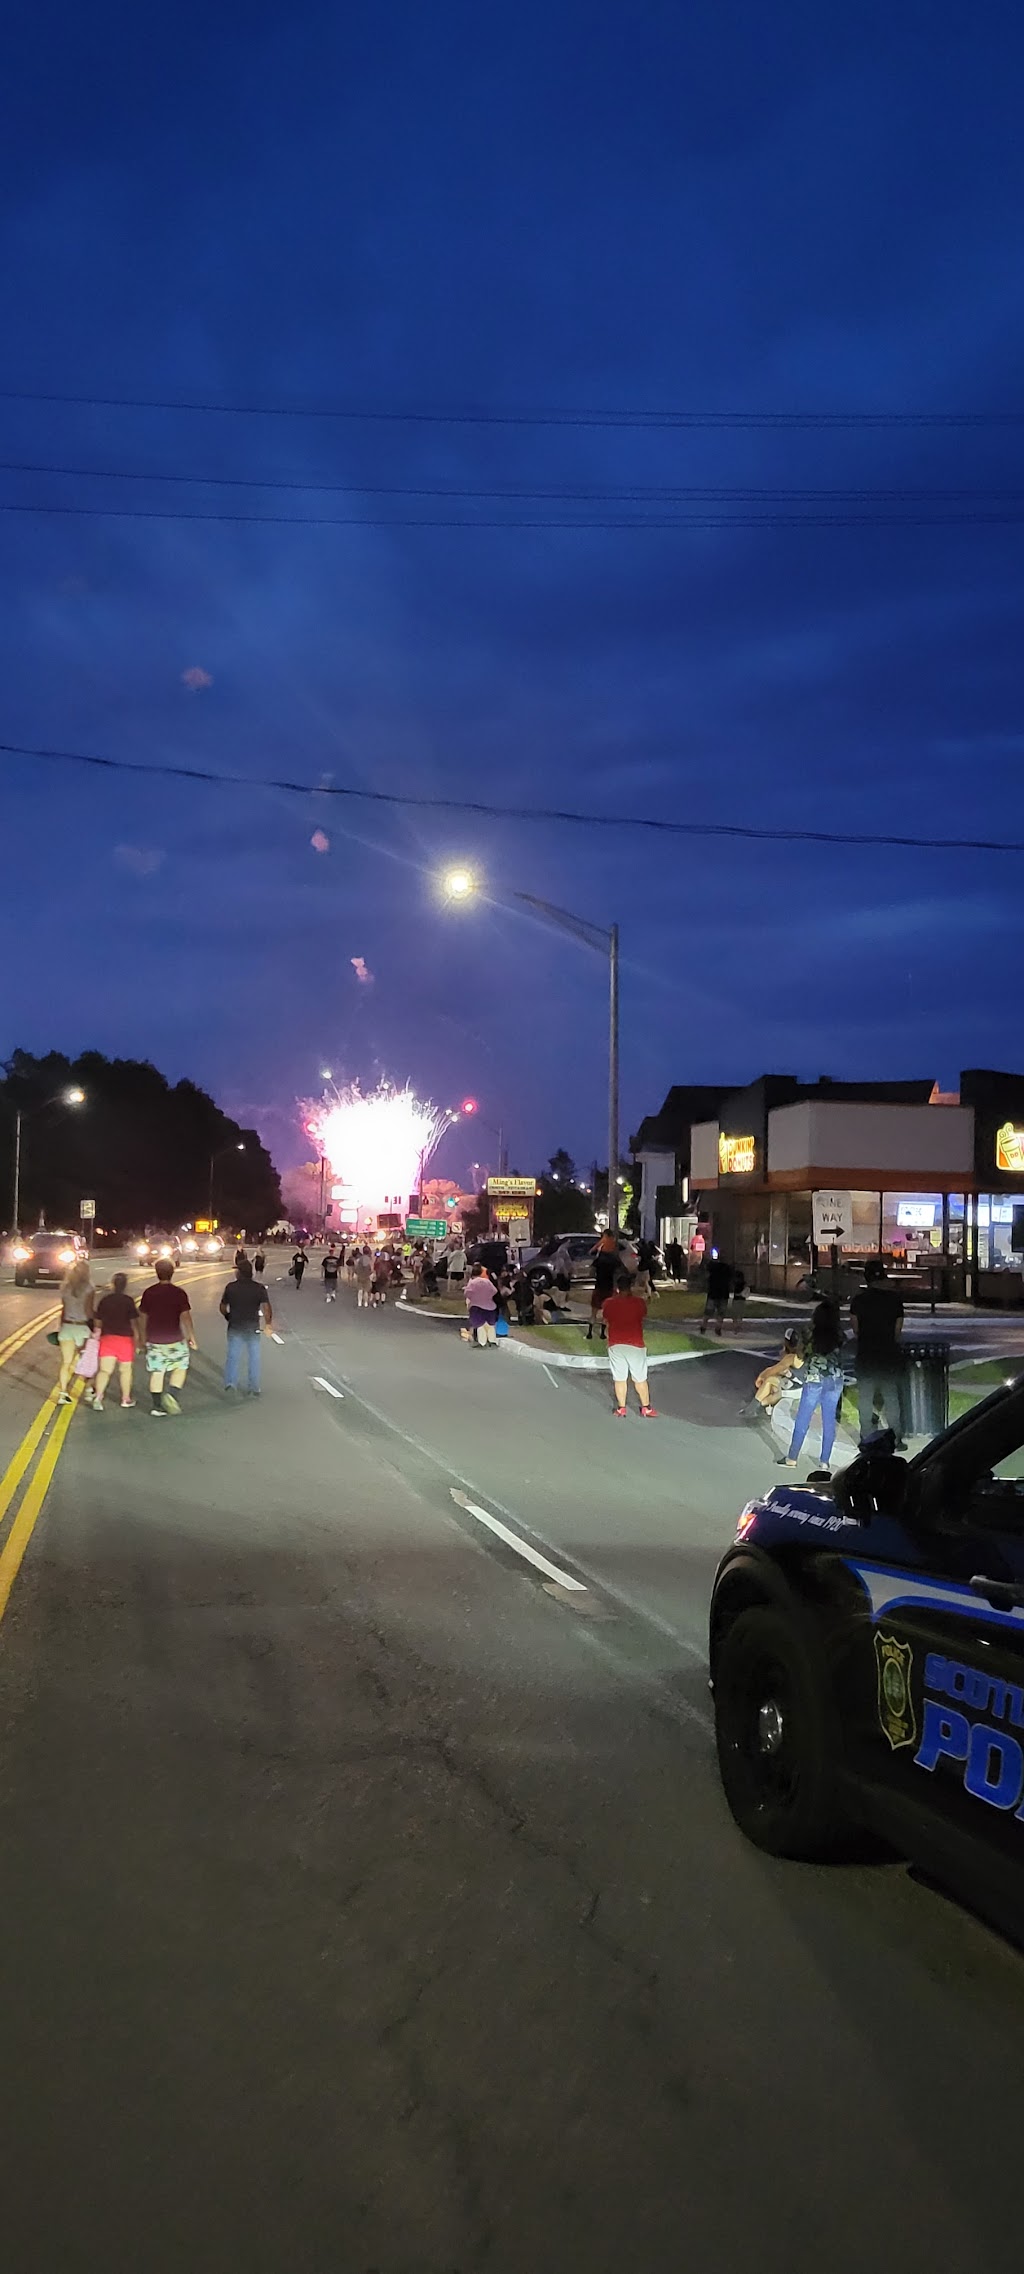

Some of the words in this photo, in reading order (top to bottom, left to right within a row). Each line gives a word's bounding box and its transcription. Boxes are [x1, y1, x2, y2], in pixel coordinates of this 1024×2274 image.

[493, 1178, 513, 1186] Ming's
[822, 1212, 843, 1222] WAY
[924, 1652, 1024, 1729] SCOTI
[913, 1697, 1024, 1823] PO
